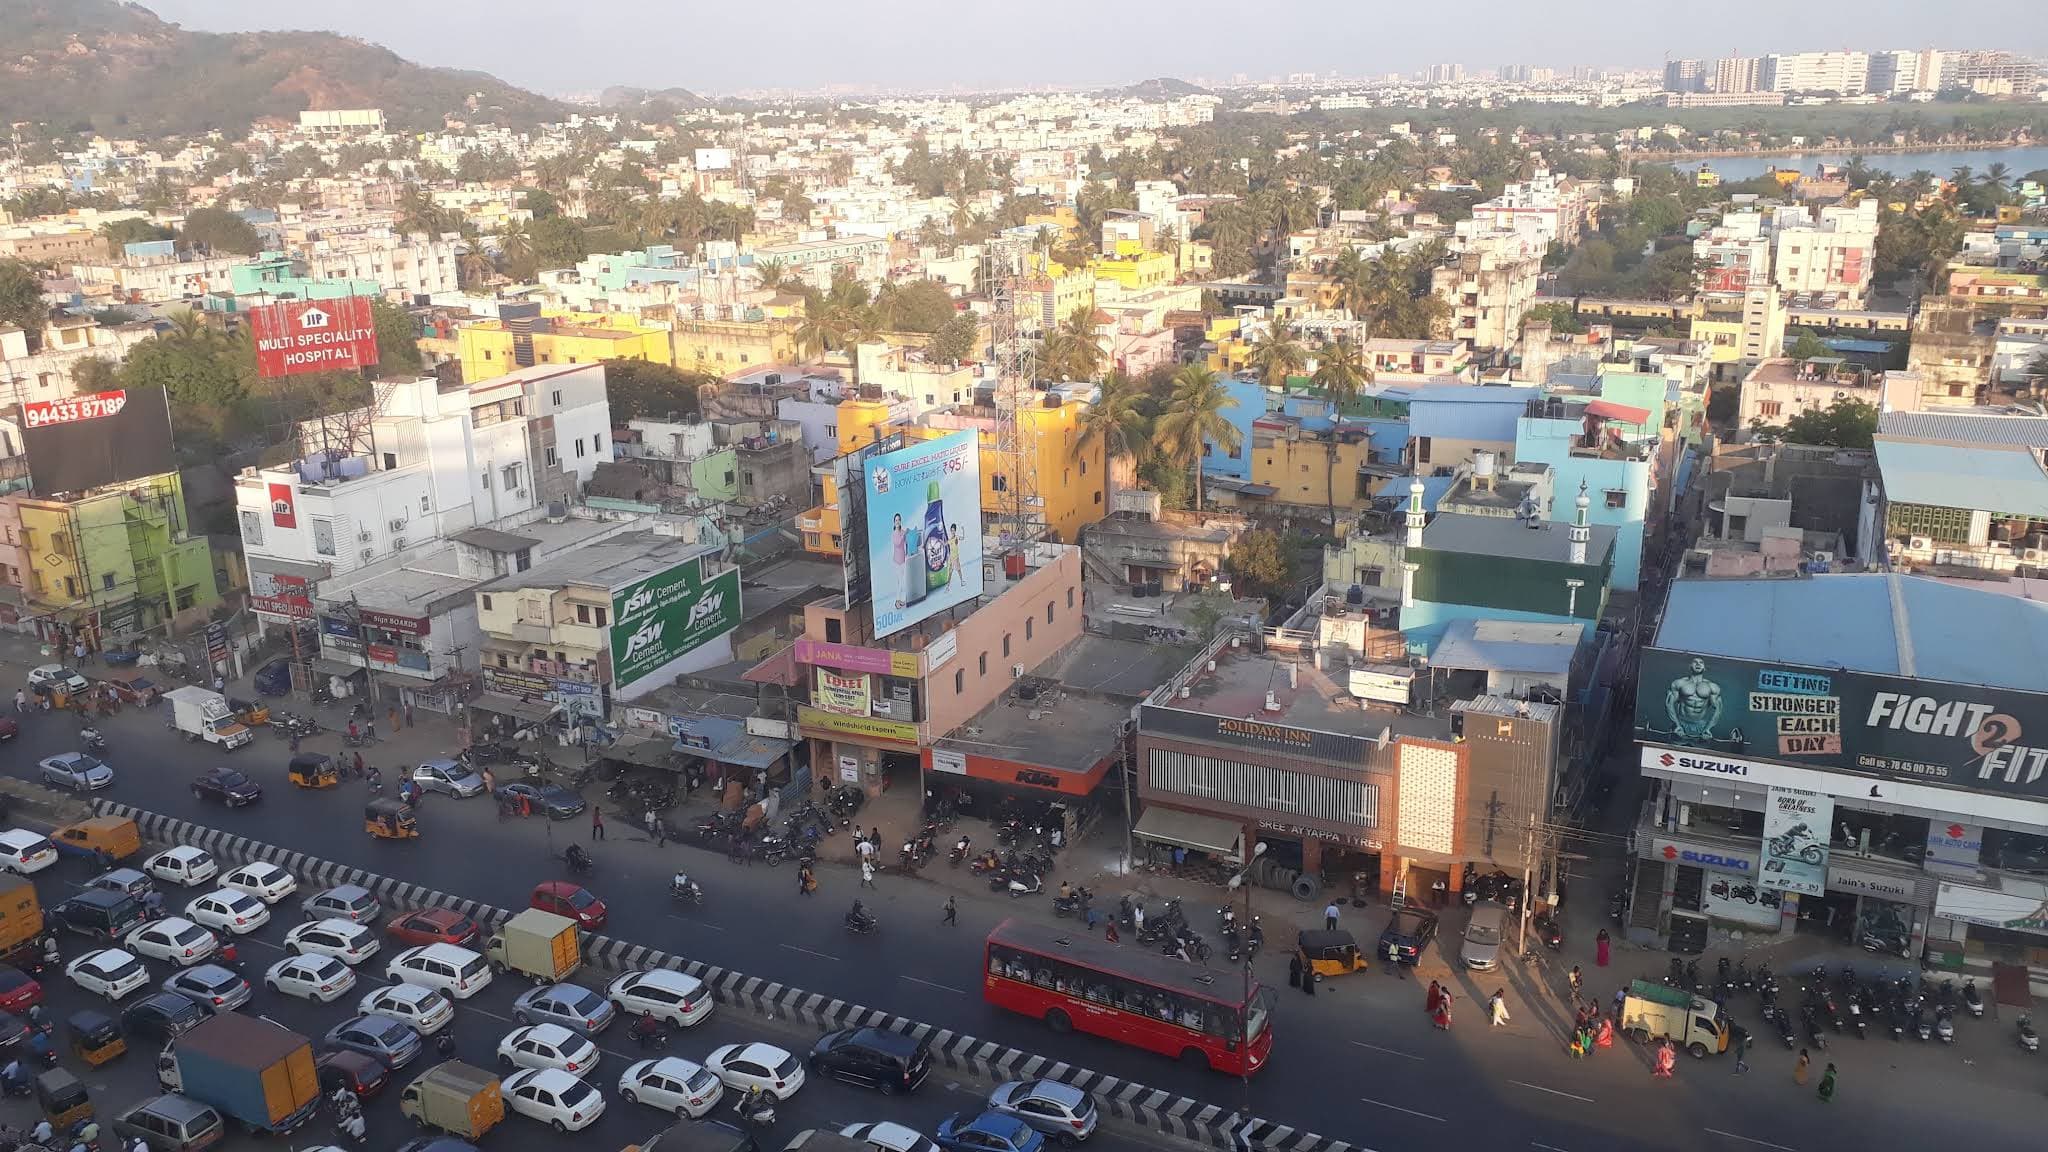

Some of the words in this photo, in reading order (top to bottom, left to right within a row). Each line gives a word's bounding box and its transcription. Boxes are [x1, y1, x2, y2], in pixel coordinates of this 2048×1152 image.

[306, 314, 322, 326] JIP
[259, 336, 294, 351] MULTI
[298, 328, 372, 346] SPECIALITY
[286, 347, 352, 365] HOSPITAL
[27, 404, 78, 426] 94433
[895, 475, 912, 488] NOW
[275, 502, 288, 513] JIP
[620, 585, 654, 620] JSW
[657, 578, 686, 599] Cement
[271, 602, 305, 616] SPECILITY
[684, 588, 724, 630] JSW
[373, 616, 388, 625] Sign
[389, 618, 417, 628] BOARDS
[694, 609, 722, 631] Cement
[620, 616, 665, 662] JSW
[632, 640, 663, 662] Cement
[816, 650, 842, 662] JANA
[1761, 672, 1830, 692] GETTING
[1752, 696, 1837, 714] STRONGER
[1866, 691, 1995, 738] FIGHT
[833, 720, 871, 731] Windshield
[1218, 719, 1281, 738] HOLIDAYS
[1285, 727, 1312, 742] INN
[1781, 717, 1836, 733] EACH
[1982, 720, 2008, 748] 2
[1218, 729, 1254, 739] BUSINESS
[1284, 739, 1312, 748] ROOMS
[1787, 736, 1826, 753] DAY
[1679, 757, 1748, 776] SUZUKI
[1859, 755, 1876, 766] Call
[1876, 759, 1886, 768] us
[1901, 762, 1912, 772] 45
[1925, 764, 1936, 775] 75
[1936, 765, 1948, 776] 55
[1977, 744, 2048, 784] FIT
[1777, 796, 1796, 805] BORN
[1258, 819, 1286, 832] SREE
[1291, 825, 1340, 842] AYYAPPA
[1345, 836, 1383, 850] TYRES
[1681, 850, 1749, 870] SUZUKI
[1837, 876, 1866, 888] Jain's
[1869, 881, 1905, 895] Suzuki
